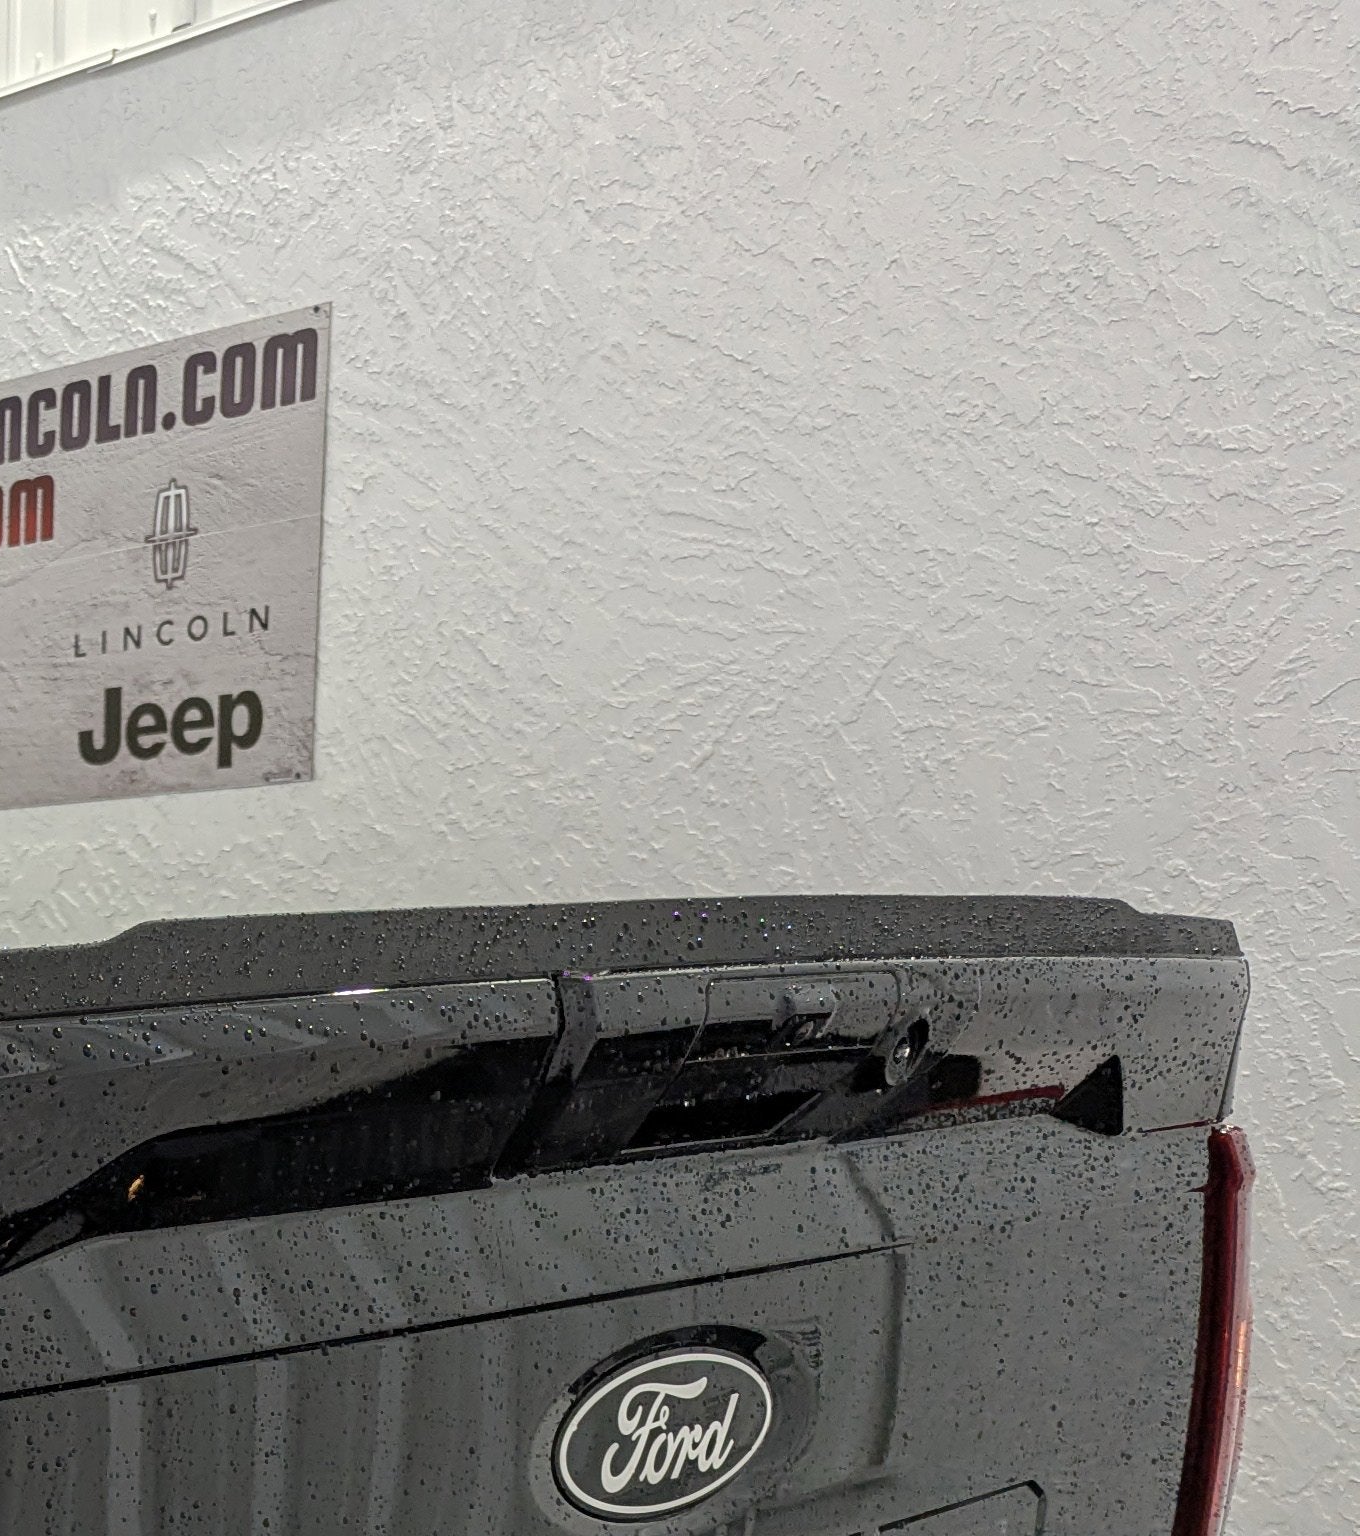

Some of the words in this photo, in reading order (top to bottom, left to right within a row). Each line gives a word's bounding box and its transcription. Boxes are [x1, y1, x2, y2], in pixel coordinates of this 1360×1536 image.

[74, 604, 271, 660] LINCOLN
[79, 686, 265, 769] Jeep
[601, 1376, 740, 1493] Ford
